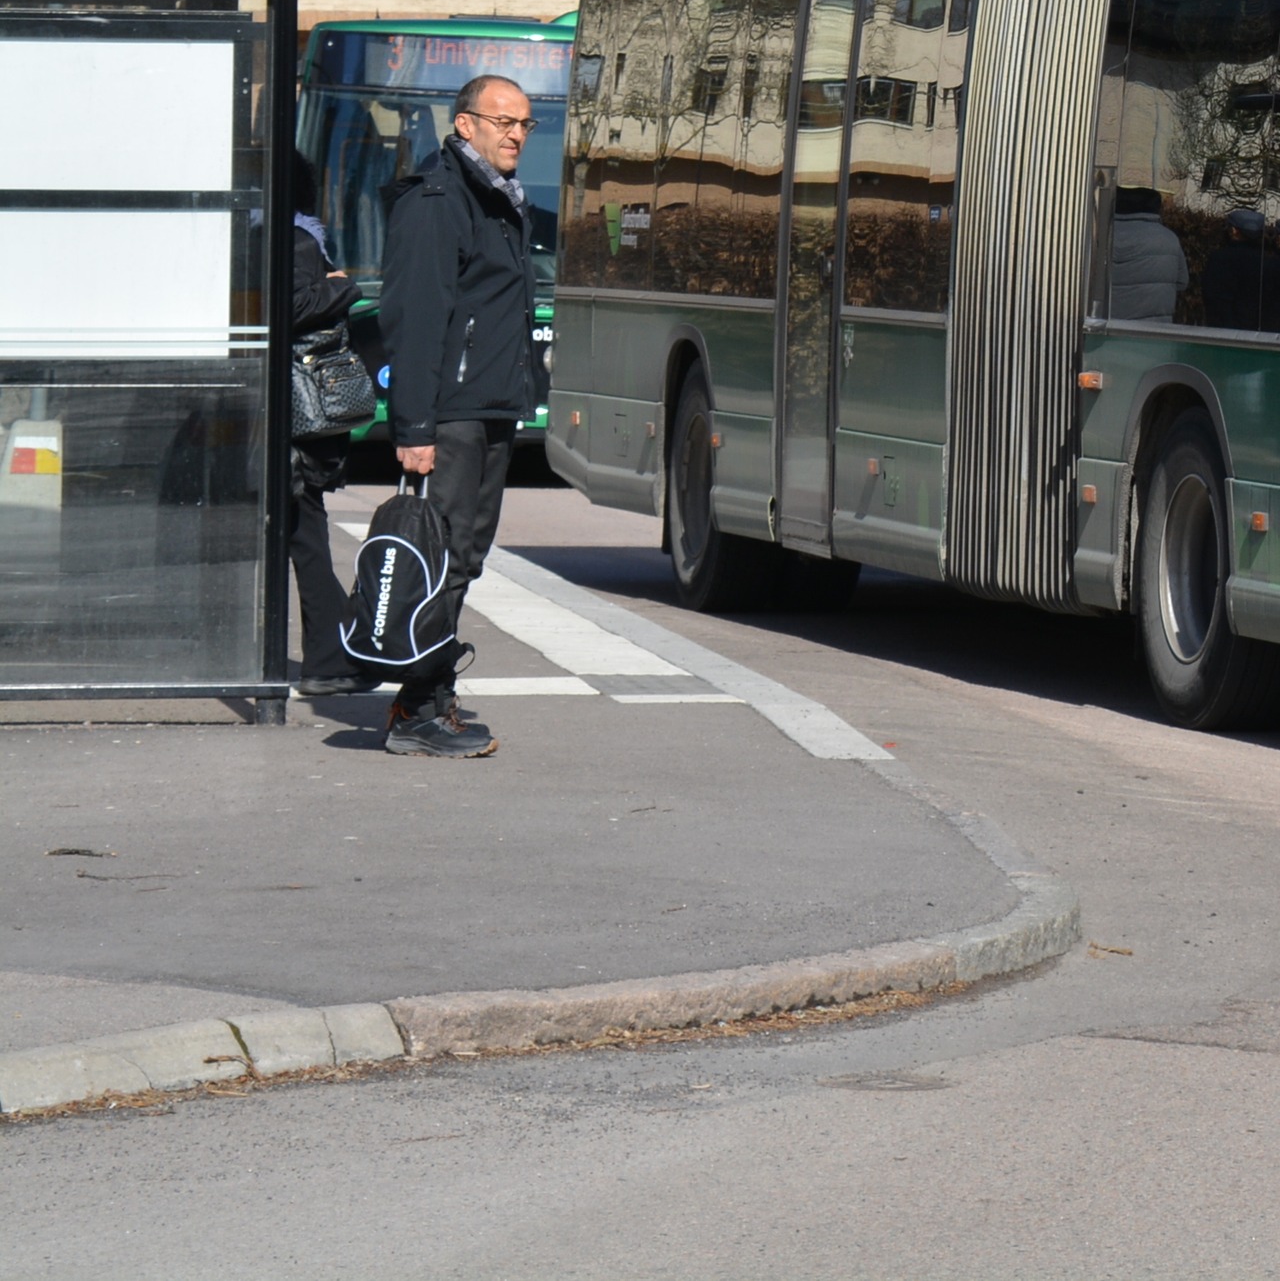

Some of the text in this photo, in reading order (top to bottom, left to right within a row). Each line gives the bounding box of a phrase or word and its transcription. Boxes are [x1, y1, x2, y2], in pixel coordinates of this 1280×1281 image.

[387, 35, 405, 71] 3
[373, 547, 397, 637] connect bus
